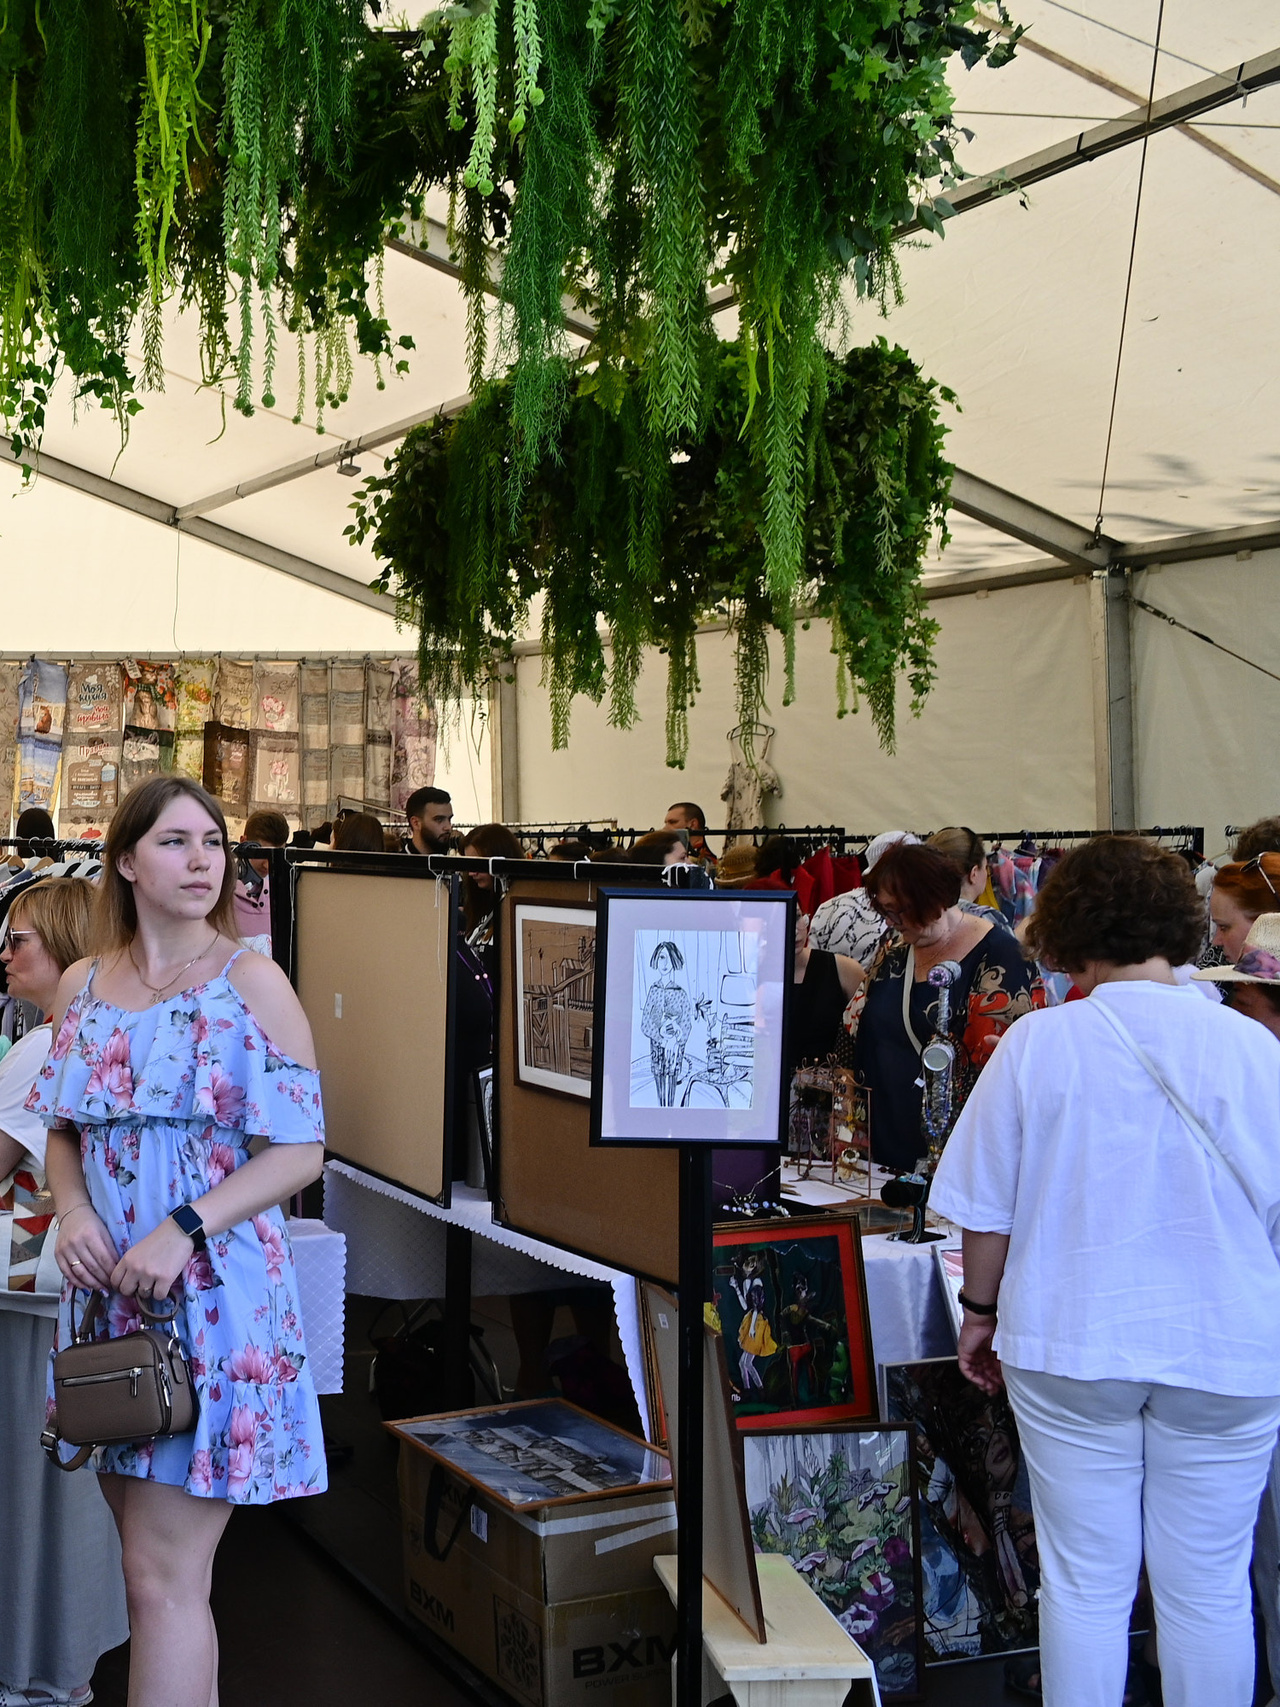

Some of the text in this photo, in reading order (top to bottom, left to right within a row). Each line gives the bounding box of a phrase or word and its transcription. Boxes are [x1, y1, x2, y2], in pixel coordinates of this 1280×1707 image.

[81, 683, 103, 694] Моя
[410, 1579, 454, 1632] BXM
[572, 1634, 678, 1679] BXM
[584, 1674, 629, 1690] POWER
